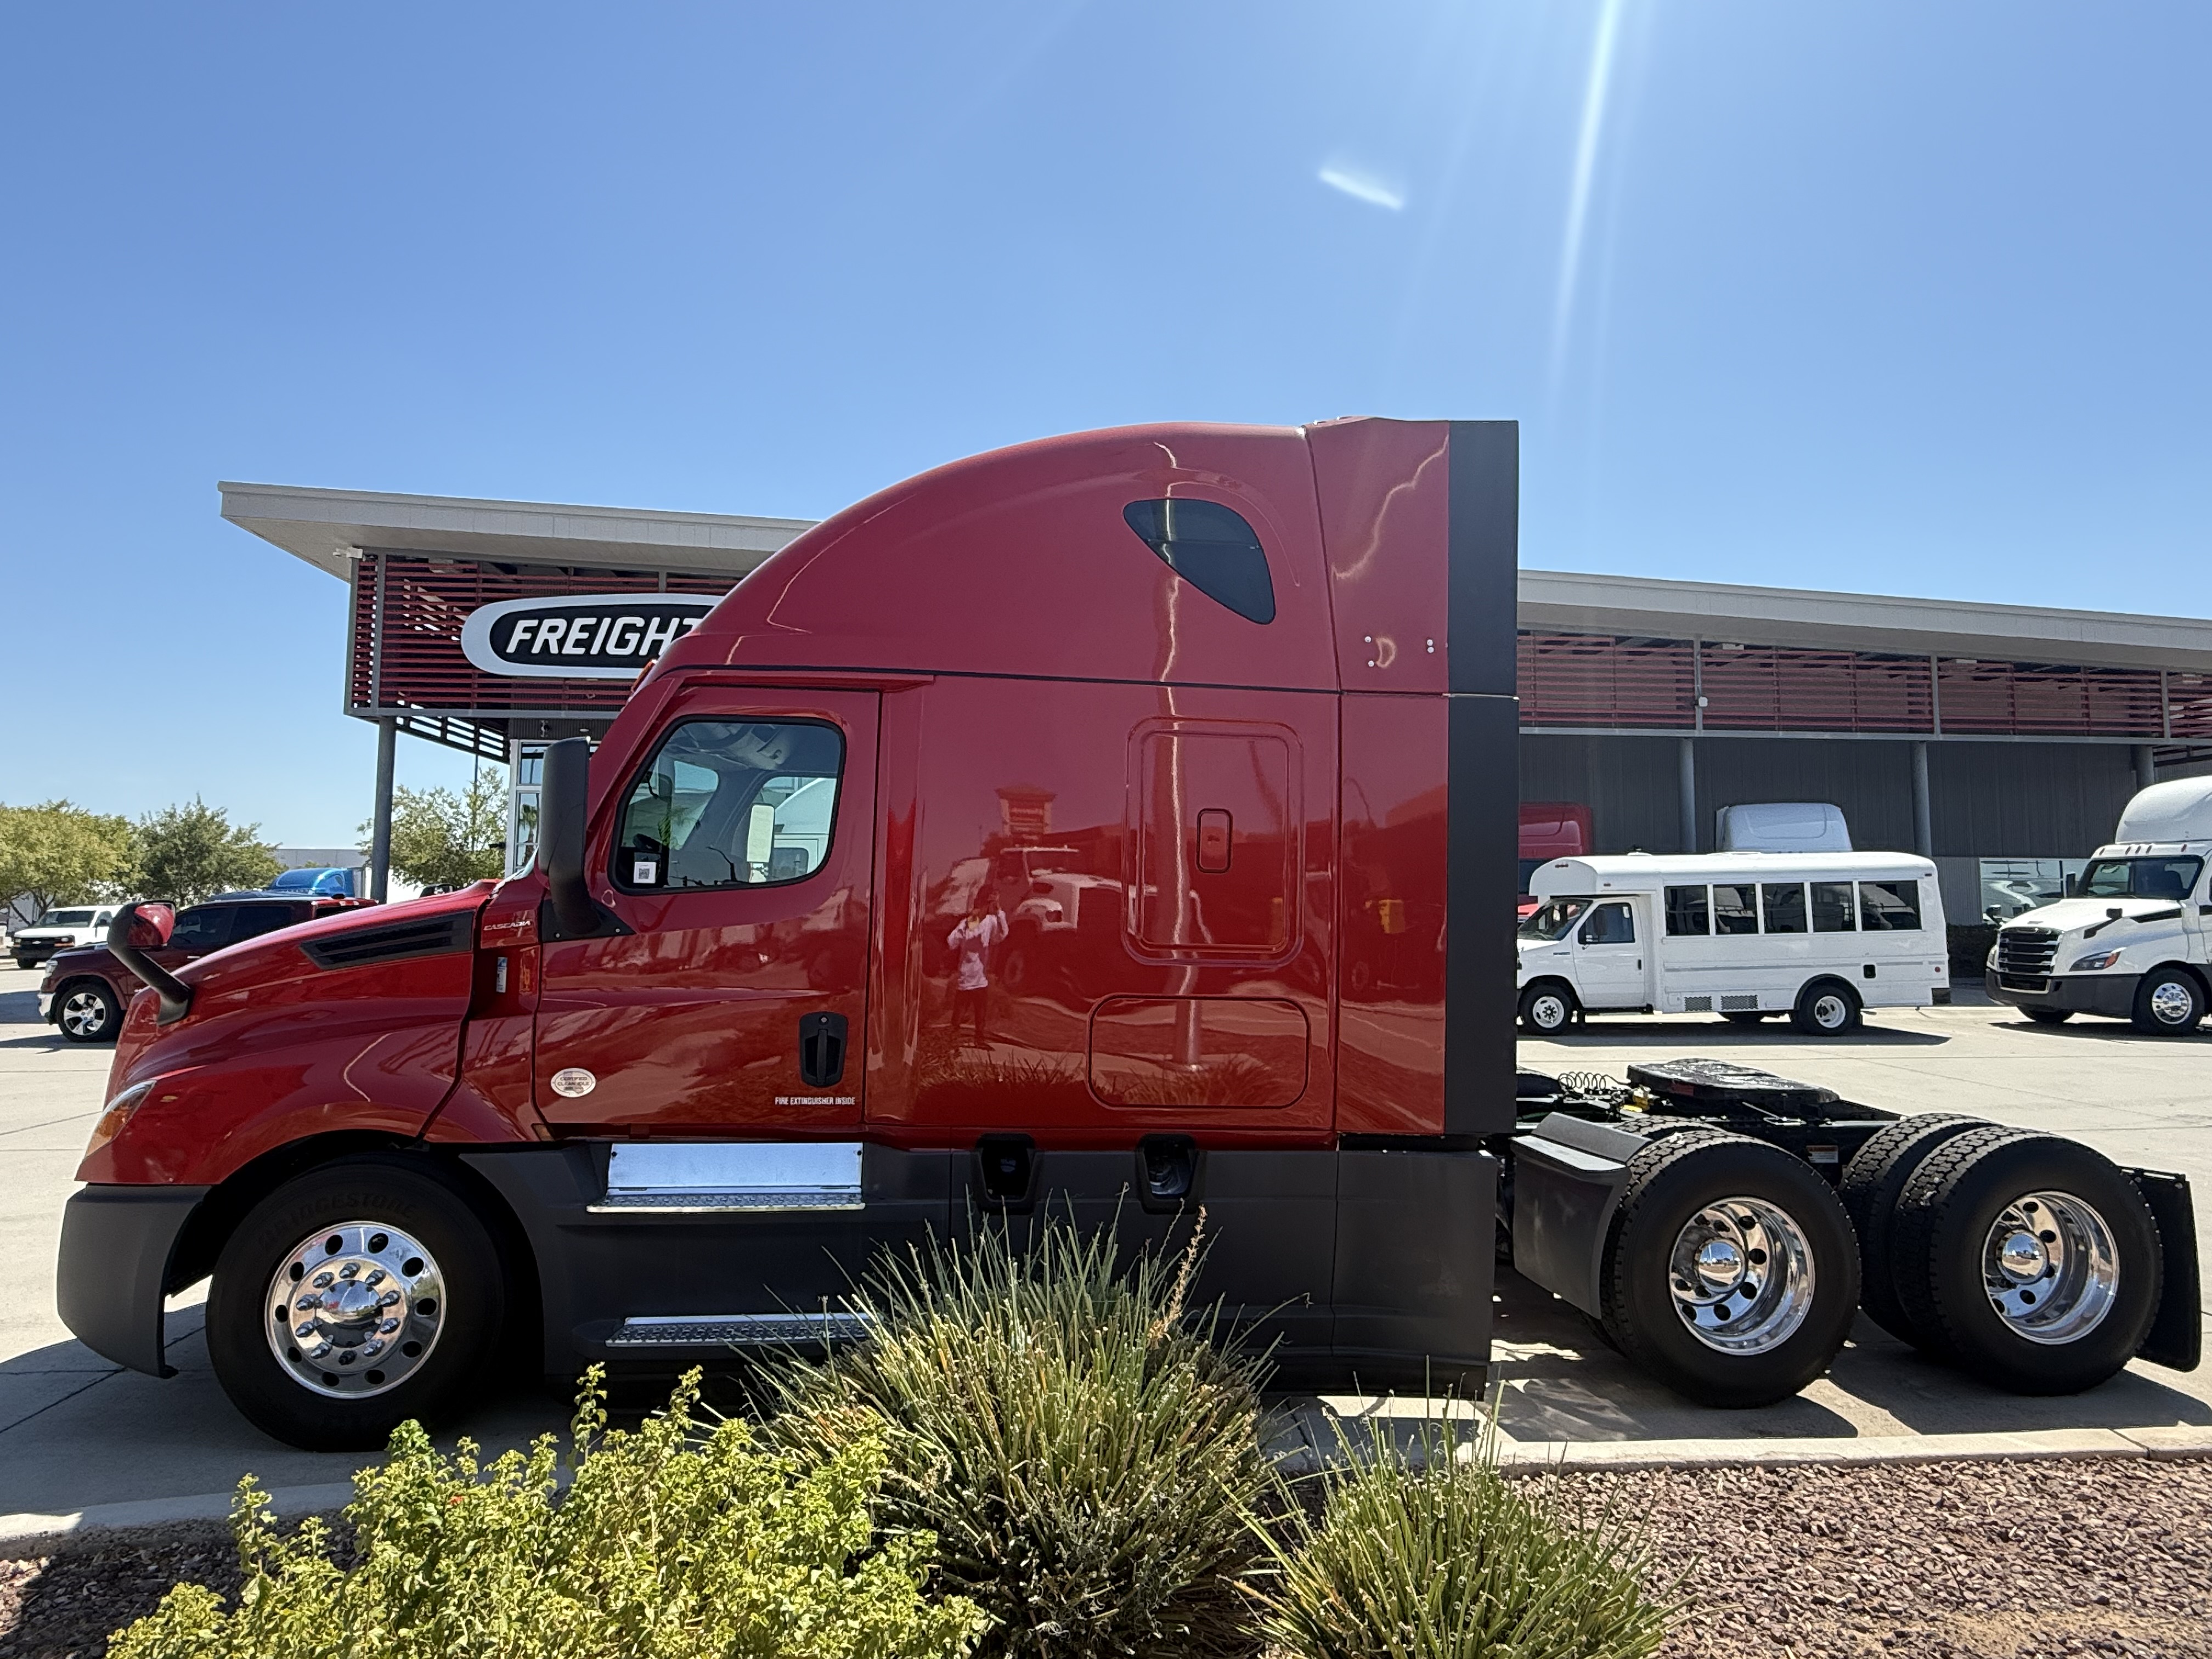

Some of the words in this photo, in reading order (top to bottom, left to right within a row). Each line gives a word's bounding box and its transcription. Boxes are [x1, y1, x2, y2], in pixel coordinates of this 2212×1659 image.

[483, 920, 531, 931] CASCADIA
[775, 1097, 789, 1105] FIRE
[790, 1097, 834, 1105] EXTINGUISHER
[835, 1097, 856, 1105] INSIDE
